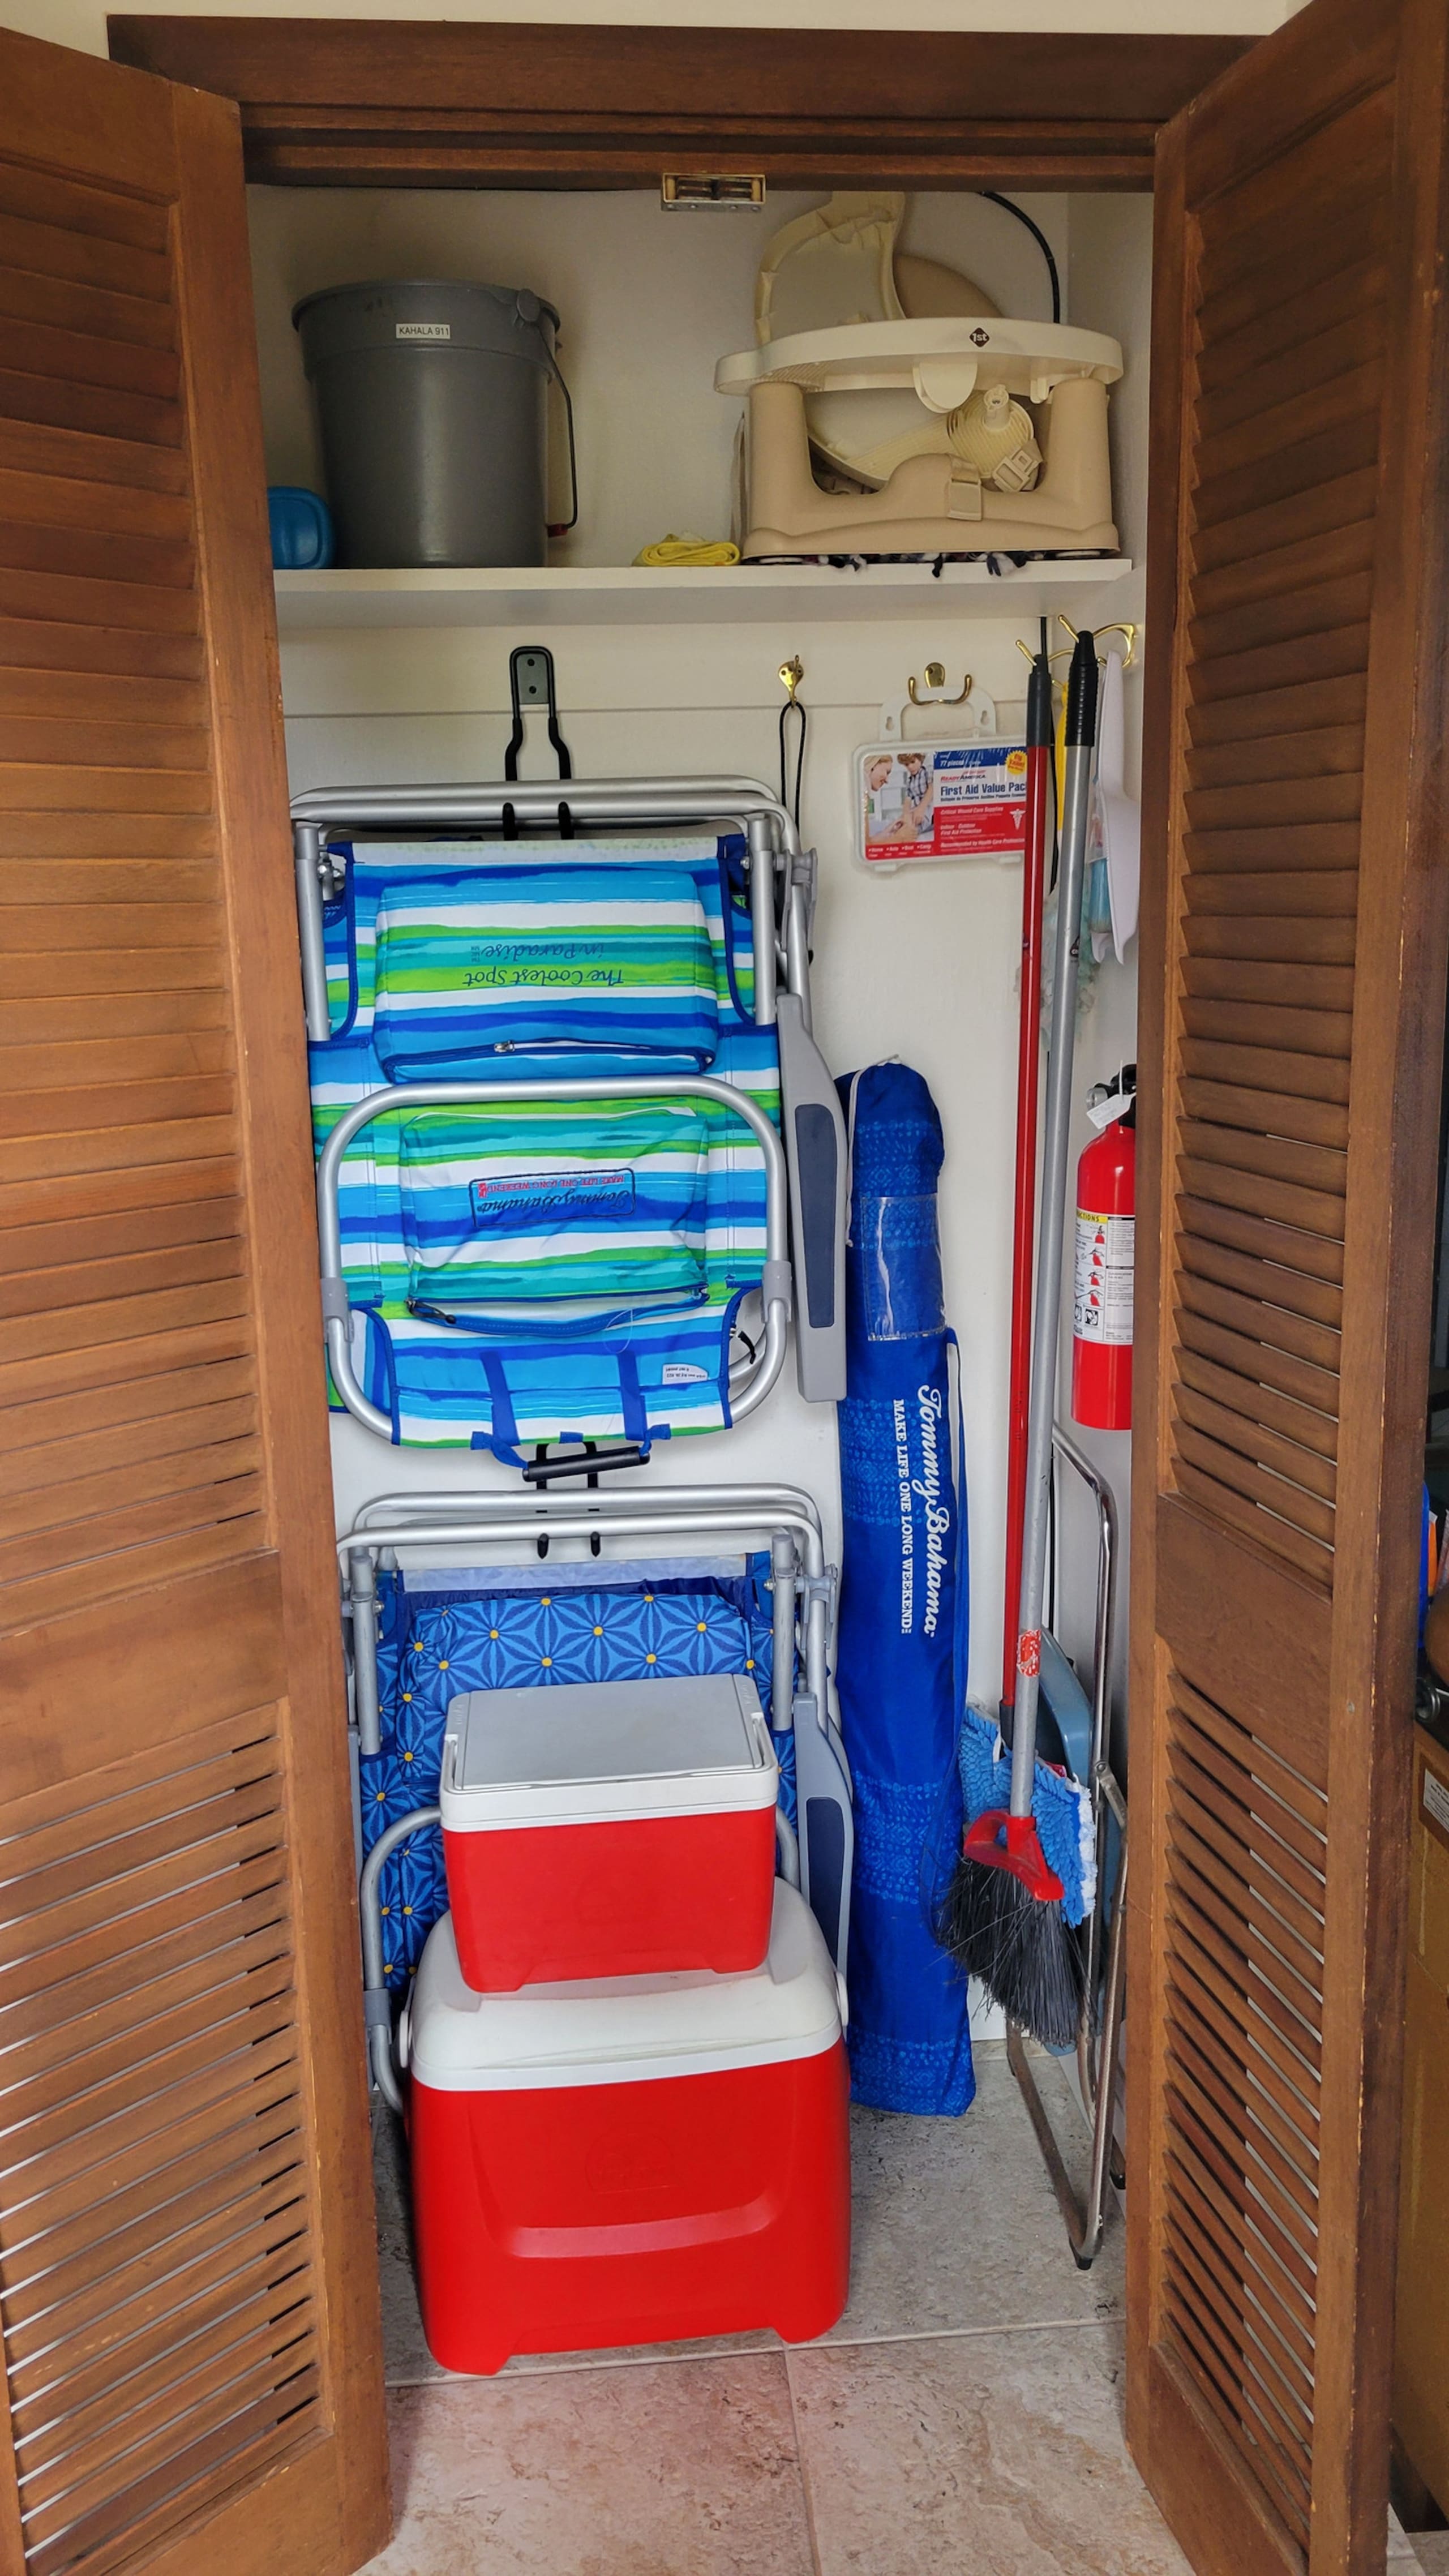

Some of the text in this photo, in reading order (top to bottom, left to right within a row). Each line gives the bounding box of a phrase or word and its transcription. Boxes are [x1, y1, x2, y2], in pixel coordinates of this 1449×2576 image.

[398, 327, 449, 335] KAHALA 911
[972, 332, 988, 342] 1st
[941, 785, 962, 796] First
[965, 784, 979, 795] Aid
[982, 783, 1005, 793] Value
[481, 943, 576, 962] Paradise
[579, 943, 605, 959] in
[462, 966, 624, 987] The Coolest Spot
[1077, 1211, 1099, 1222] CTIONS
[893, 1399, 906, 1441] MAKE
[897, 1445, 909, 1478] LIFE
[899, 1481, 912, 1512] ONE
[901, 1515, 913, 1555] LONG
